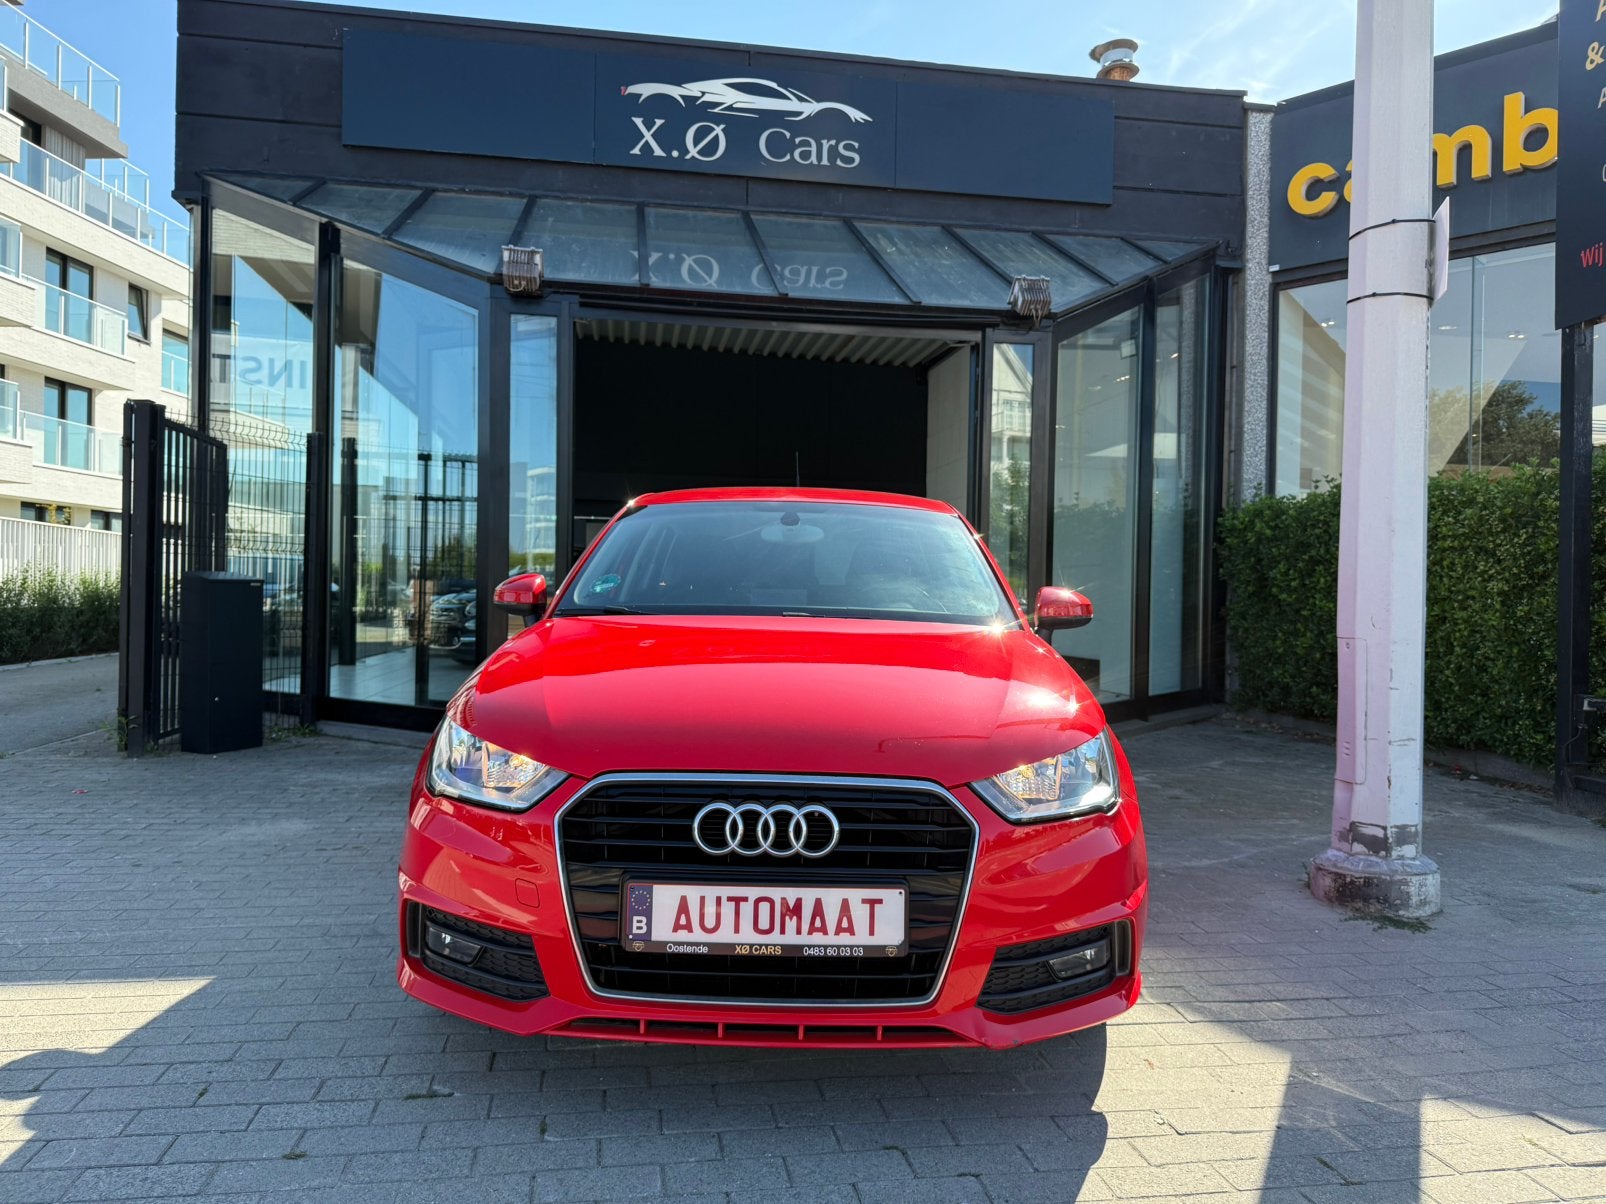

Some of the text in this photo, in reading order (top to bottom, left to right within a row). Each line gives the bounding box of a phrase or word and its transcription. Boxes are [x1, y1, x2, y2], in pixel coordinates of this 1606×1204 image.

[1586, 41, 1605, 70] &
[759, 128, 861, 168] Cars
[1287, 92, 1558, 216] cmb
[1581, 242, 1604, 268] wij
[632, 915, 647, 934] B
[672, 895, 883, 936] AUTOMAAT
[666, 943, 708, 953] Oostende
[752, 945, 782, 955] CARS
[803, 946, 824, 956] 0483
[826, 947, 838, 956] 60
[840, 947, 850, 956] 03
[853, 947, 864, 956] 03
